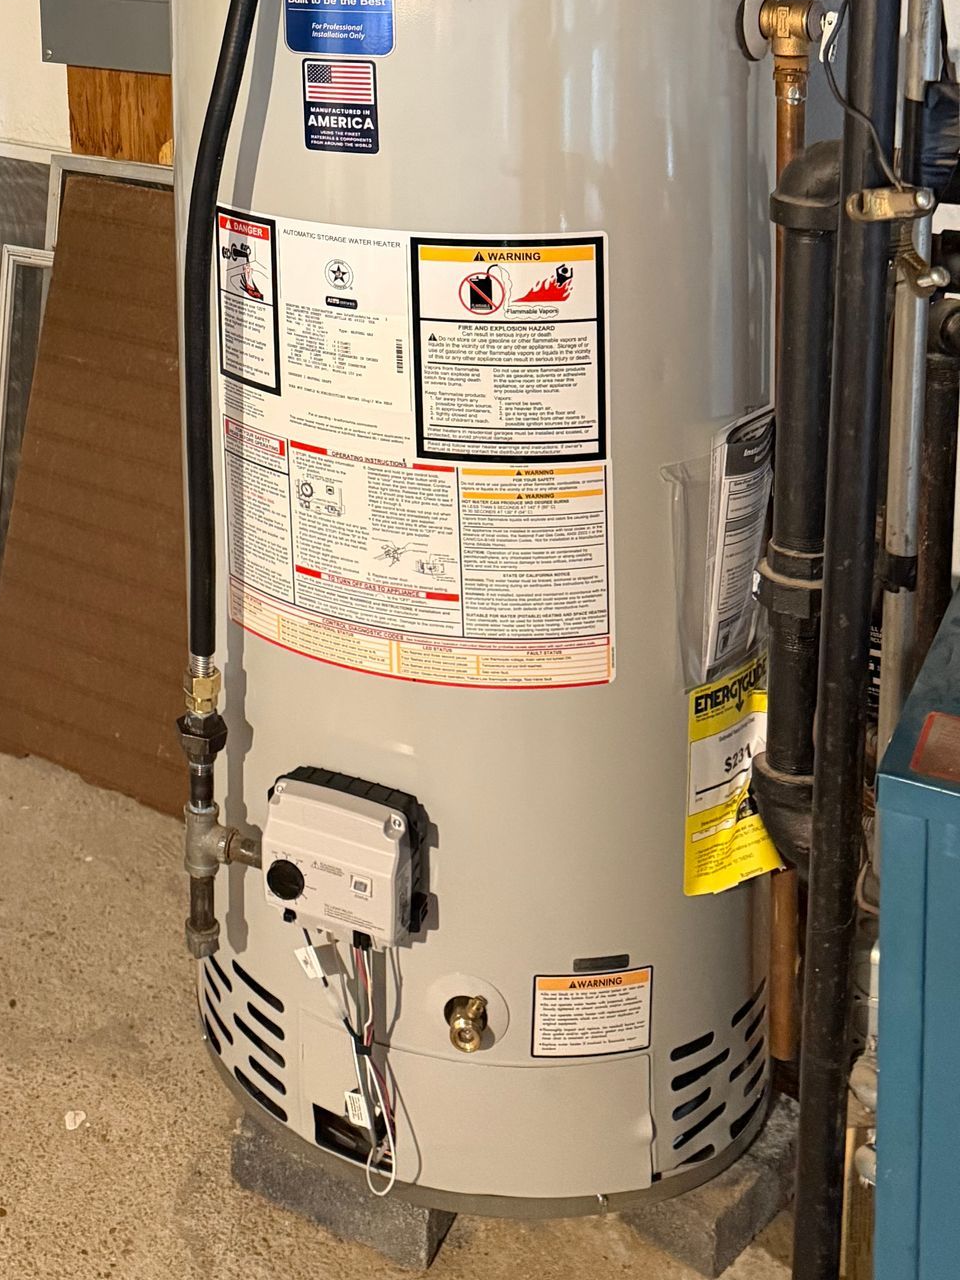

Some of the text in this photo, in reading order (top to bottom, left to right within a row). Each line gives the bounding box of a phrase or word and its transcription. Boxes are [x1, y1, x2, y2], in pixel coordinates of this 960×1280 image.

[323, 23, 363, 31] Professional
[312, 31, 365, 40] Installation Only
[308, 115, 374, 129] AMERICA
[234, 222, 263, 237] DANGER
[283, 229, 315, 239] AUTOMATIC
[317, 234, 347, 243] STORAGE
[348, 238, 372, 246] WATER
[488, 252, 541, 261] WARNING
[331, 451, 407, 468] OPERATING INSTRUCTIONS
[387, 587, 419, 597] APPLIANCE
[322, 618, 348, 629] CONTROL
[384, 632, 404, 640] CODES
[577, 977, 622, 989] WARNING
